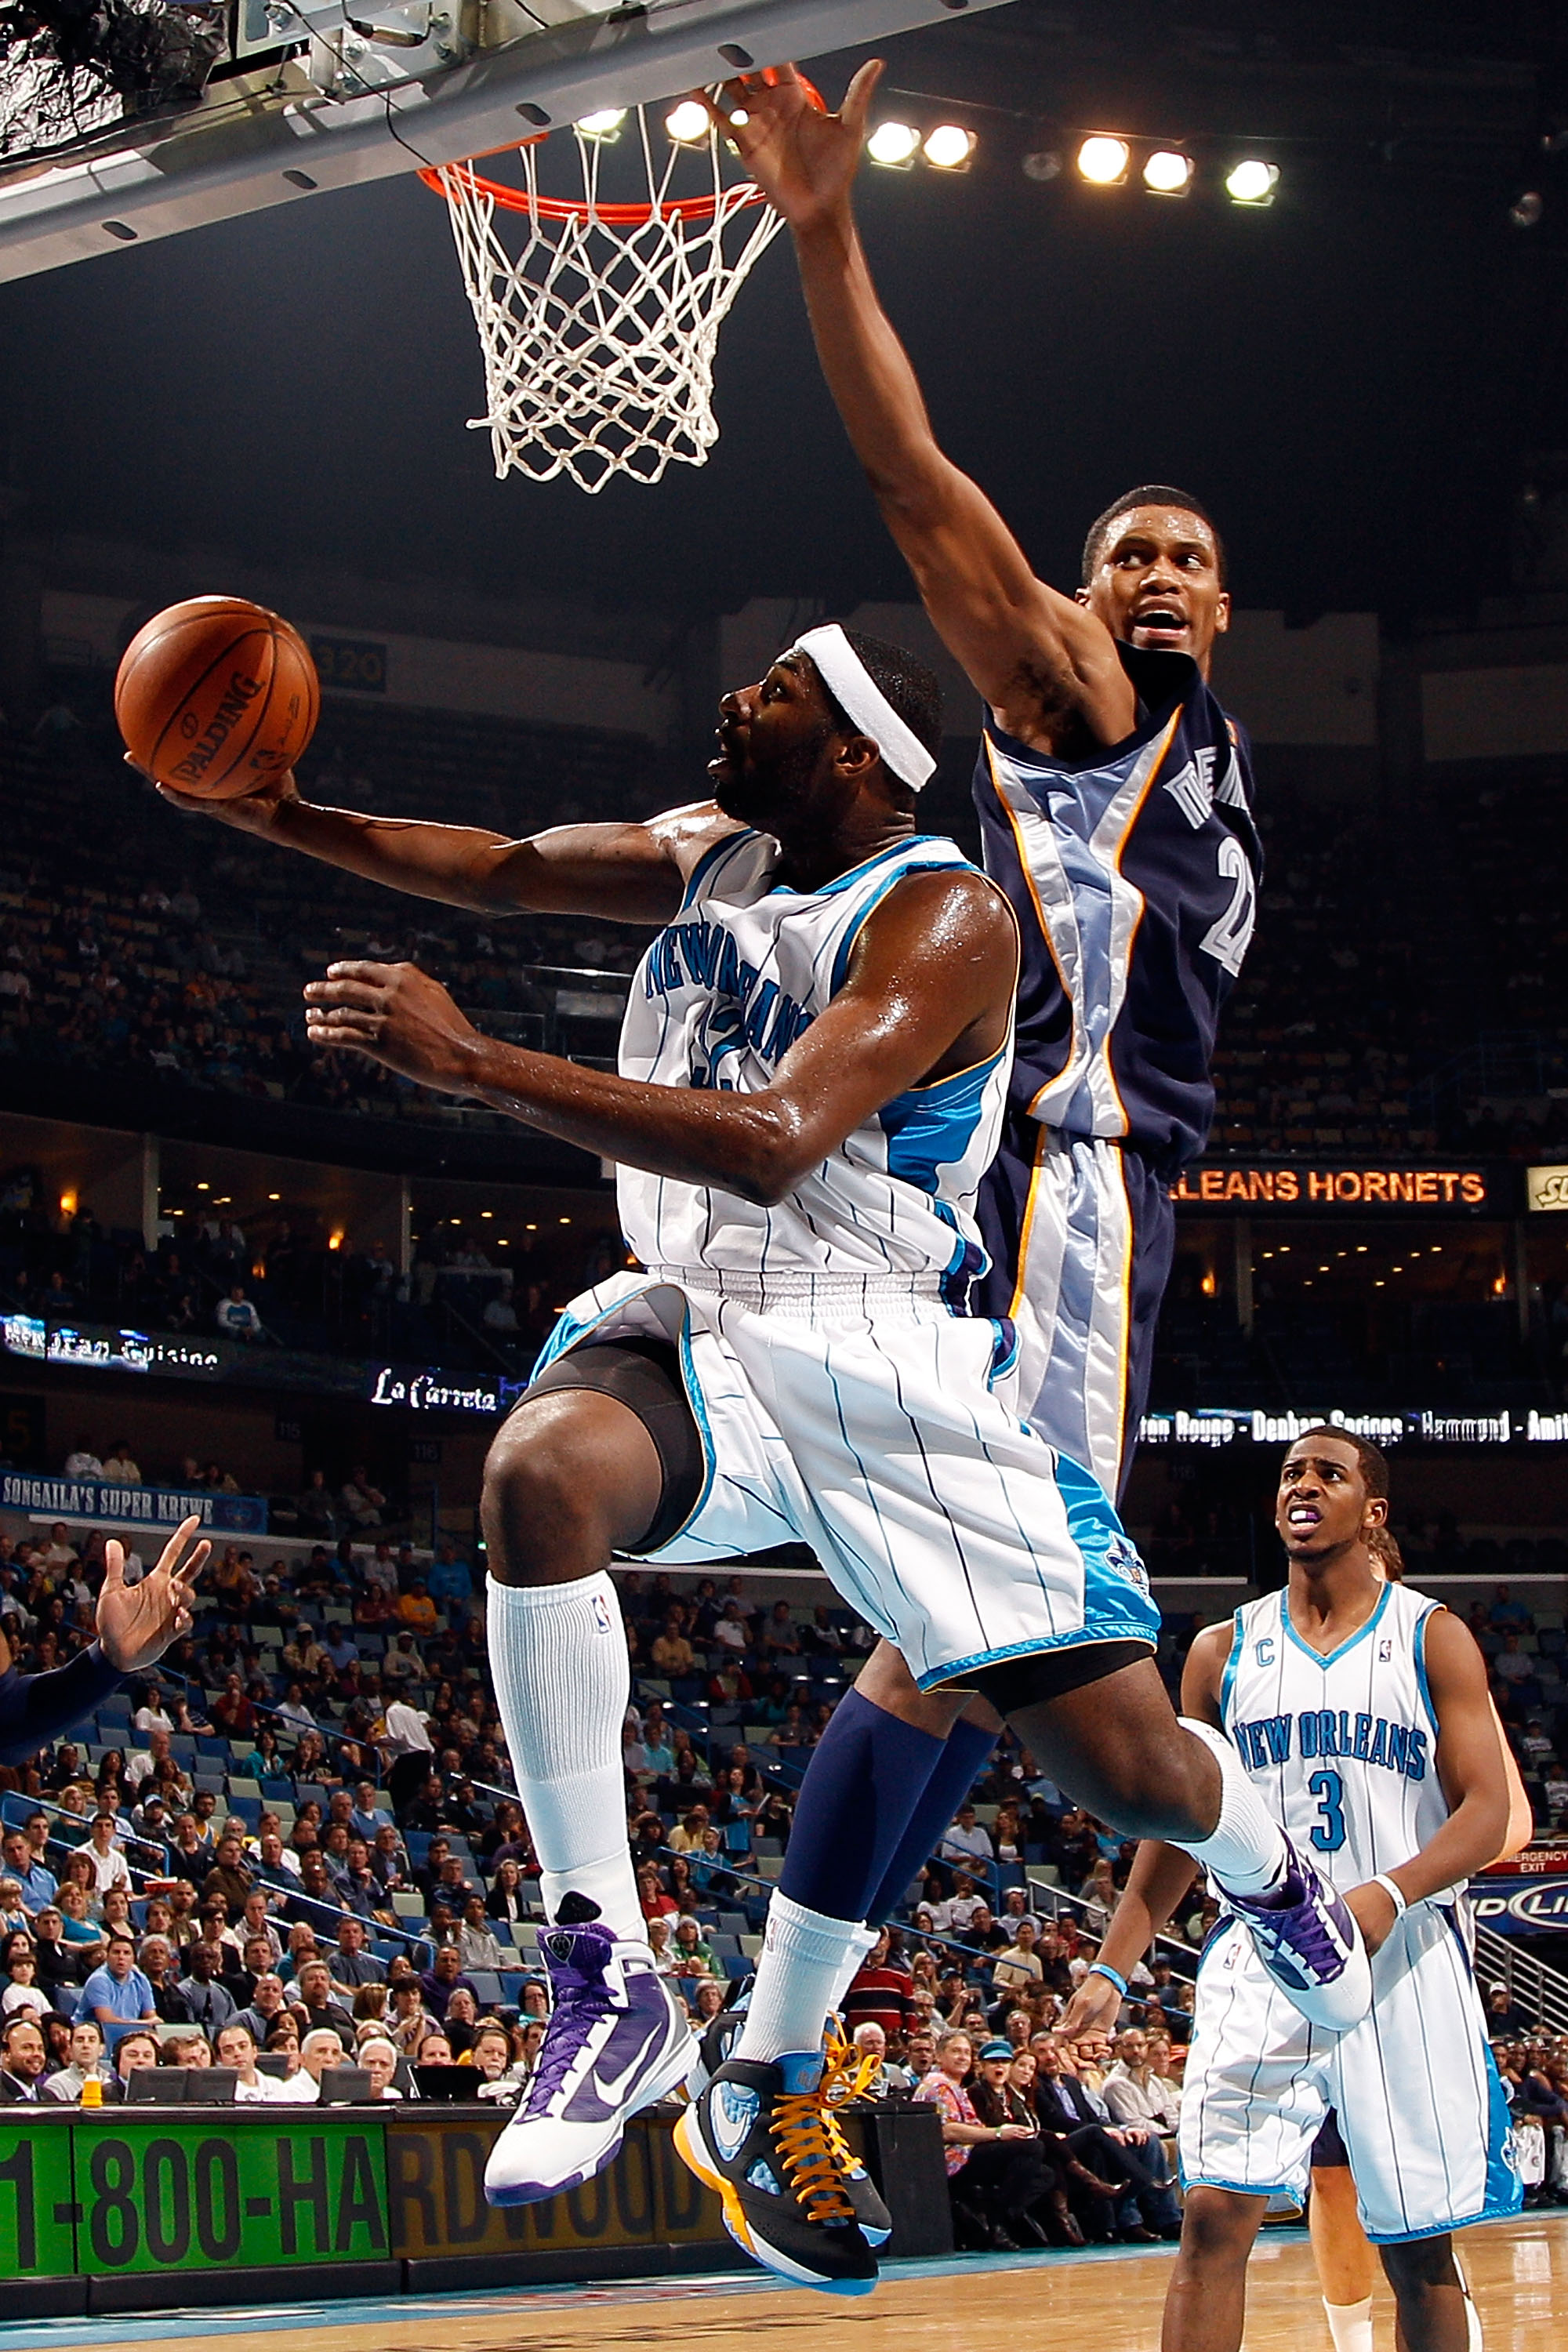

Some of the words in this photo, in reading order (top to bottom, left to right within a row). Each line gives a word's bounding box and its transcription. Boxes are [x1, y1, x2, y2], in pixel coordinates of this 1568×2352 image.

[646, 922, 711, 1000] NEW
[1168, 1169, 1300, 1201] LEANS
[1308, 1171, 1486, 1203] HORNETS
[371, 1368, 405, 1405] La
[1138, 1414, 1171, 1443] ton
[1176, 1410, 1236, 1447] Rouge
[1422, 1410, 1511, 1443] Hammond
[2, 1475, 96, 1515] SONGAILA'S
[99, 1488, 153, 1519] SUPER
[158, 1494, 213, 1525] KREWE
[1255, 1638, 1276, 1668] C
[1232, 1713, 1293, 1773] NEW
[1298, 1709, 1428, 1781] ORLEANS
[1308, 1769, 1347, 1852] 3
[1520, 1862, 1546, 1873] EXIT
[1528, 1893, 1568, 1915] LI
